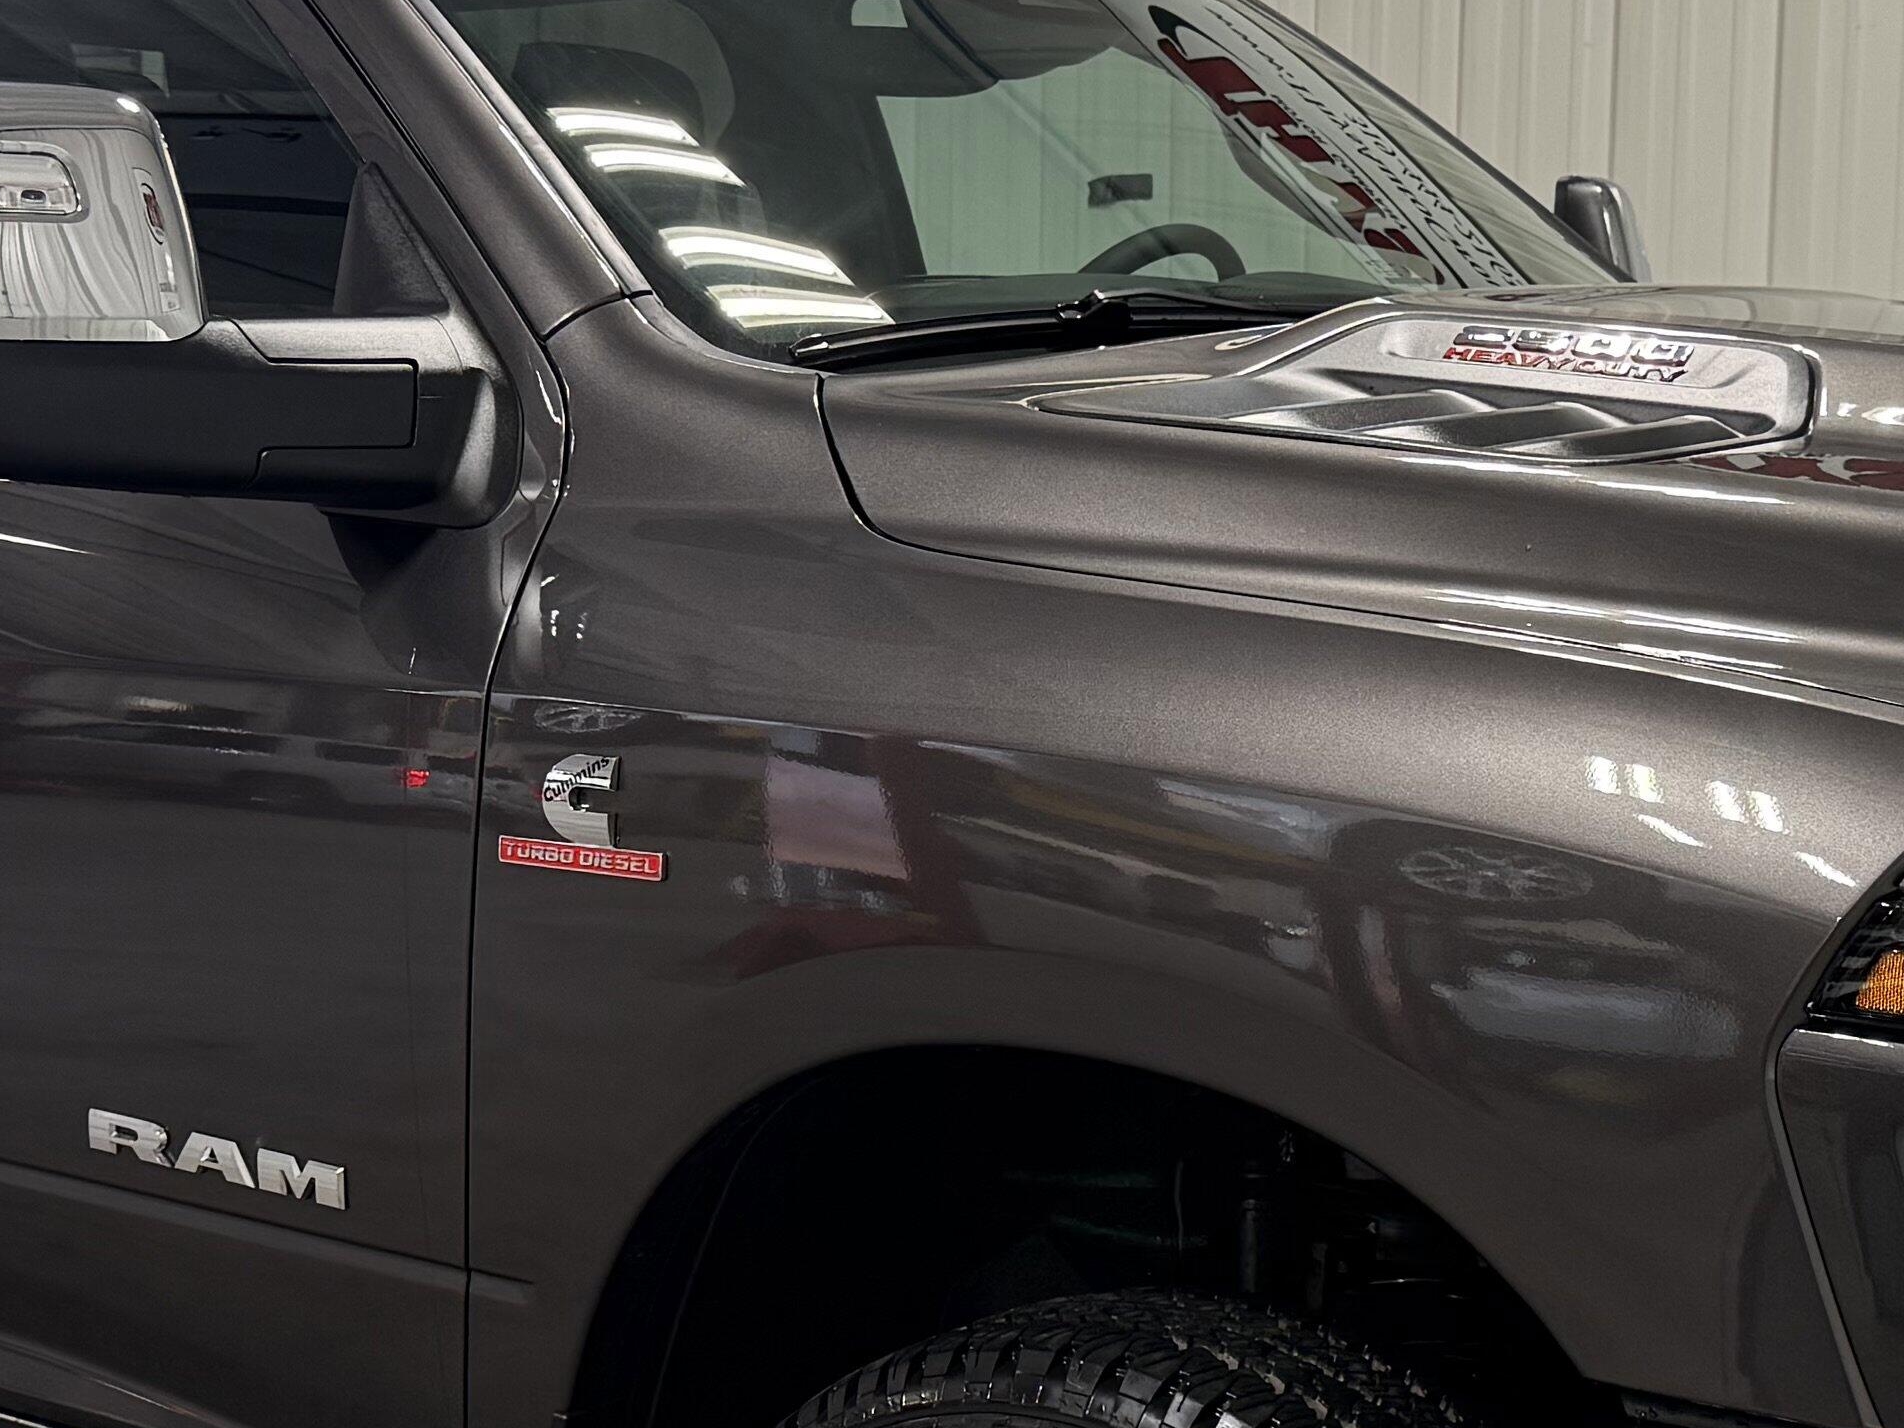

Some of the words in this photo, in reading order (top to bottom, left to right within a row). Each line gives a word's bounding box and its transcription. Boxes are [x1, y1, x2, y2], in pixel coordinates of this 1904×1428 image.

[1442, 346, 1576, 371] HEAVY
[1574, 358, 1689, 383] DUTY
[543, 756, 610, 803] Cummins
[502, 840, 574, 864] TURBO
[579, 850, 658, 873] DIESEL
[88, 1107, 347, 1211] RAM
